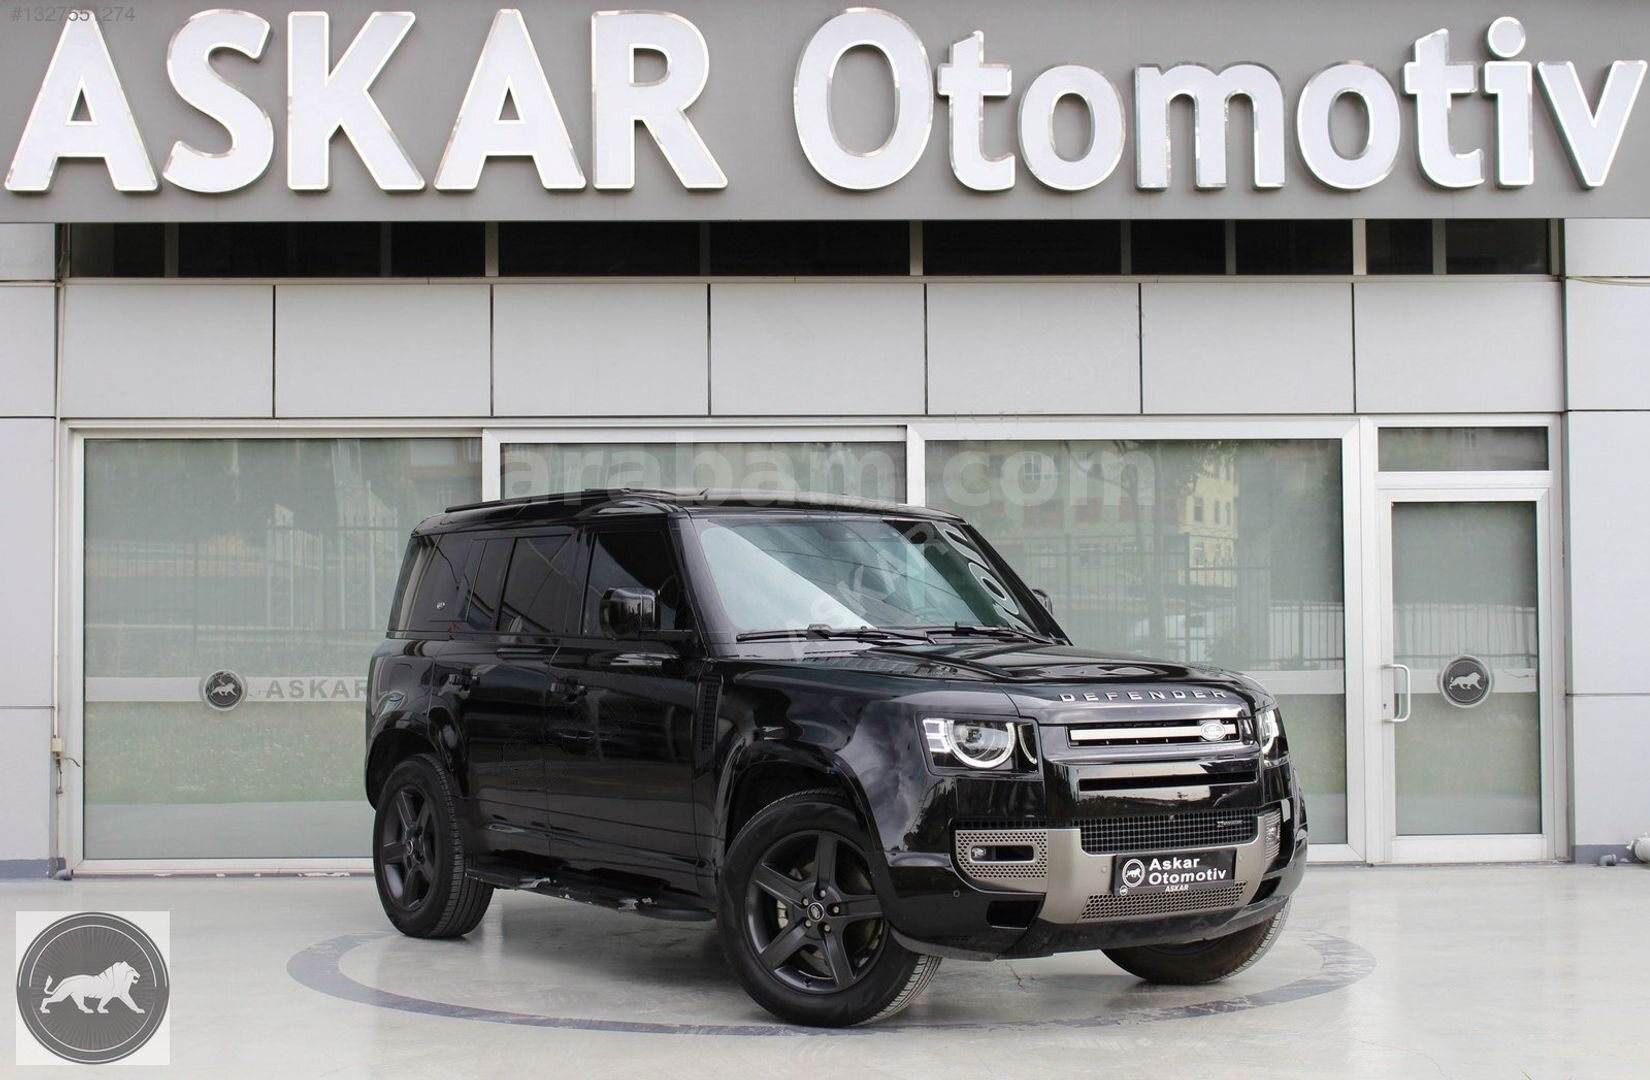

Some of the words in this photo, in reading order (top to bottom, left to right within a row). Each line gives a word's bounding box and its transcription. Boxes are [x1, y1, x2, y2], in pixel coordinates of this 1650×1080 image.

[5, 8, 729, 193] ASKAR
[793, 7, 1649, 191] Otomotiv
[265, 679, 368, 698] ASKAR
[1059, 690, 1227, 702] DEFENDER
[1149, 857, 1200, 871] Askar
[1148, 868, 1227, 885] Otomotiv
[1164, 884, 1190, 893] ASKAR
